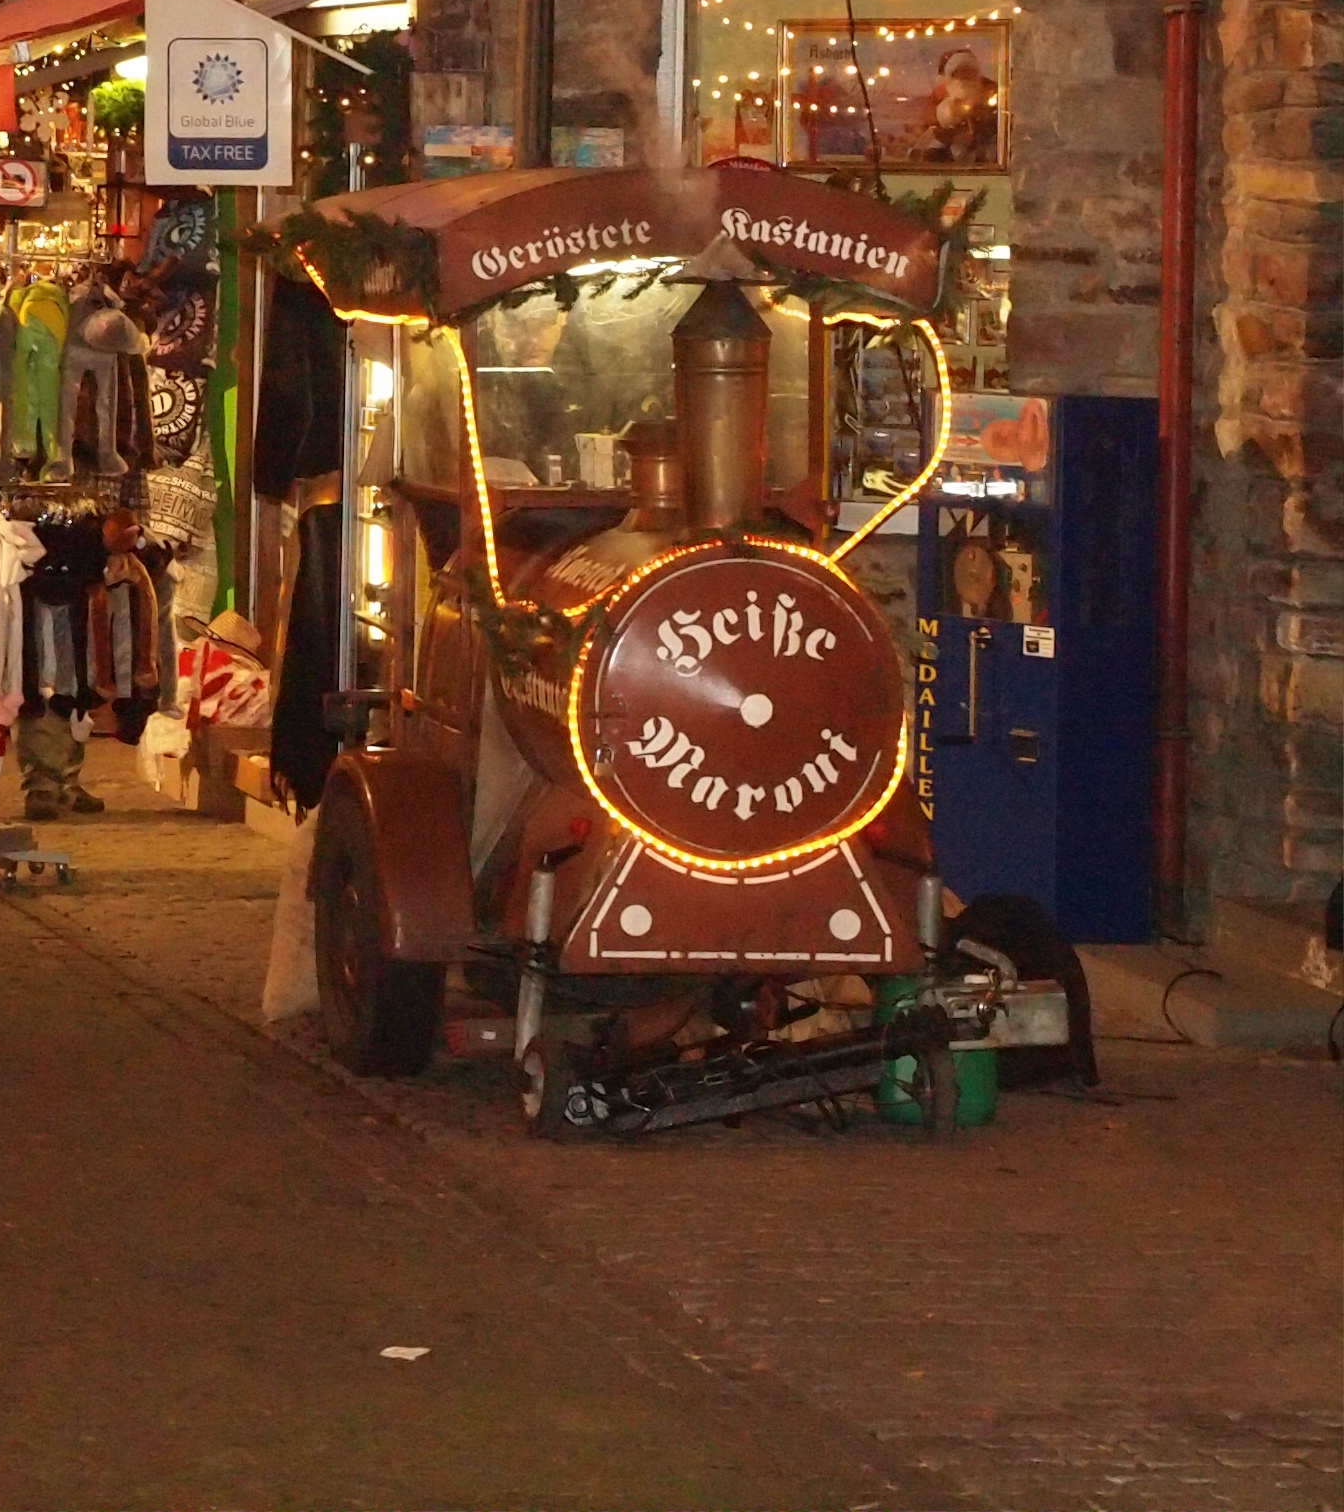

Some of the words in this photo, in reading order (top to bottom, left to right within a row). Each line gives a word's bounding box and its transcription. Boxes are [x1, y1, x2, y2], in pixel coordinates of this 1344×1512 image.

[180, 115, 223, 128] Global
[225, 114, 256, 128] Blue
[181, 145, 212, 161] TAX
[214, 145, 255, 161] FREE
[471, 215, 653, 284] Geröstete
[720, 206, 910, 281] Kastanien
[656, 587, 838, 678] Heiße
[623, 715, 858, 821] Maroni
